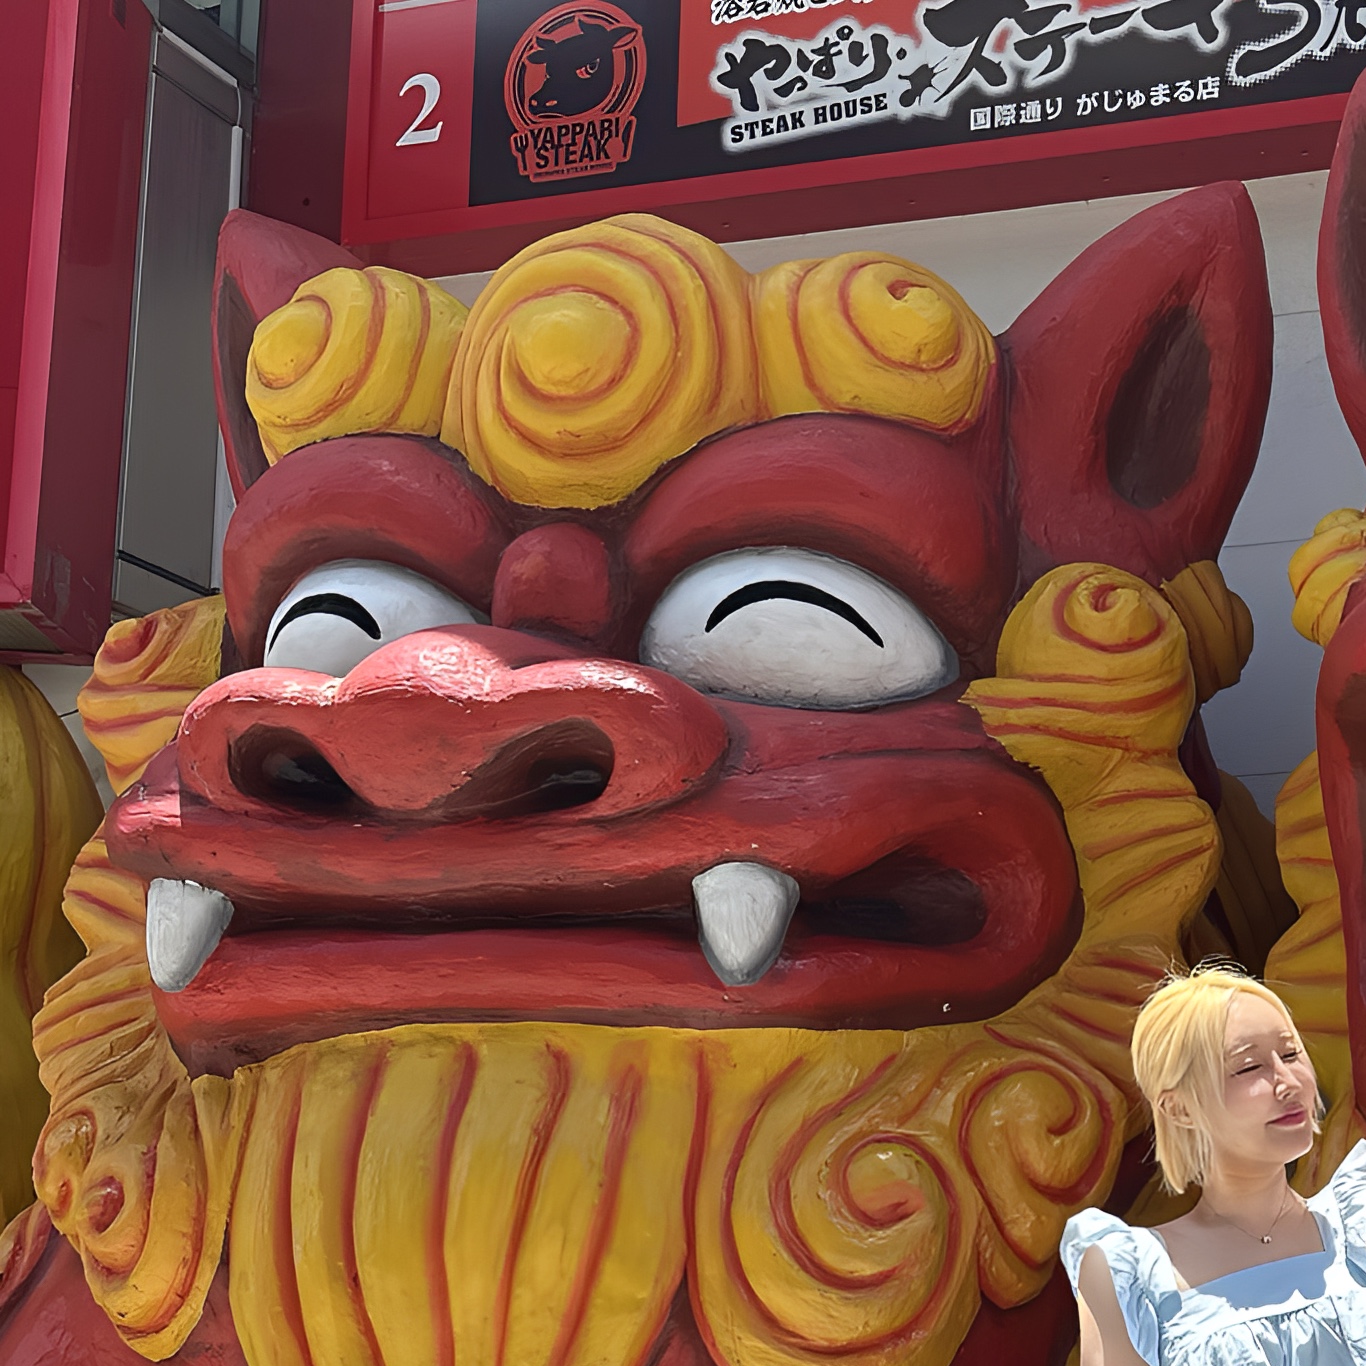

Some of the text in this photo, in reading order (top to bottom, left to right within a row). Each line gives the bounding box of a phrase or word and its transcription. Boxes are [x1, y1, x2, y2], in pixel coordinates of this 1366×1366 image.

[395, 73, 443, 147] 2
[731, 93, 888, 143] STEAK HOUSE
[970, 76, 1221, 131] 国際通り がじゅまる店
[529, 117, 620, 150] YAPPARI
[535, 136, 611, 169] STEAK
